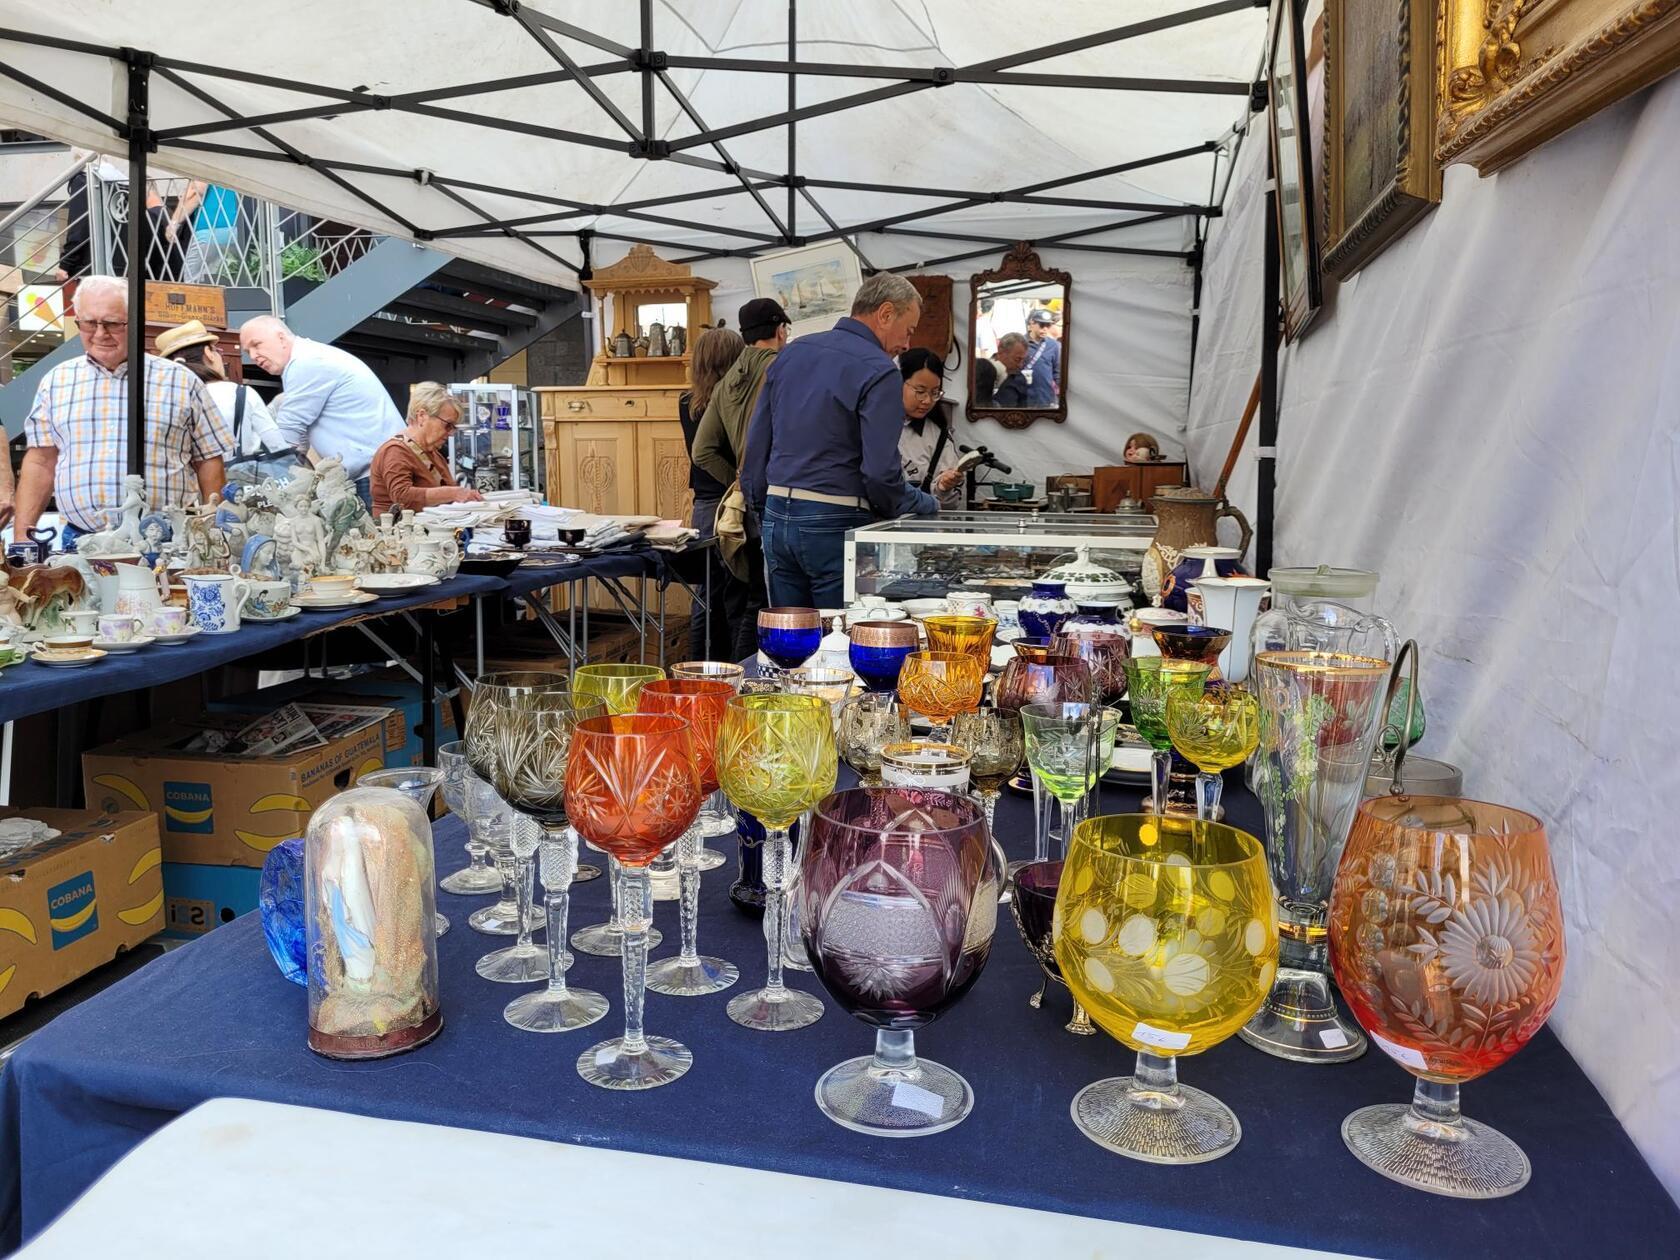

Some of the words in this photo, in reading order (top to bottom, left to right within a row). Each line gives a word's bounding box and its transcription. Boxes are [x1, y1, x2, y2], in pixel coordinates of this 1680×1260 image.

[301, 758, 333, 782] BANANAS
[334, 752, 343, 764] OF
[344, 734, 379, 758] GUATEMALA
[166, 791, 210, 802] COBANA
[50, 884, 93, 909] COBANA
